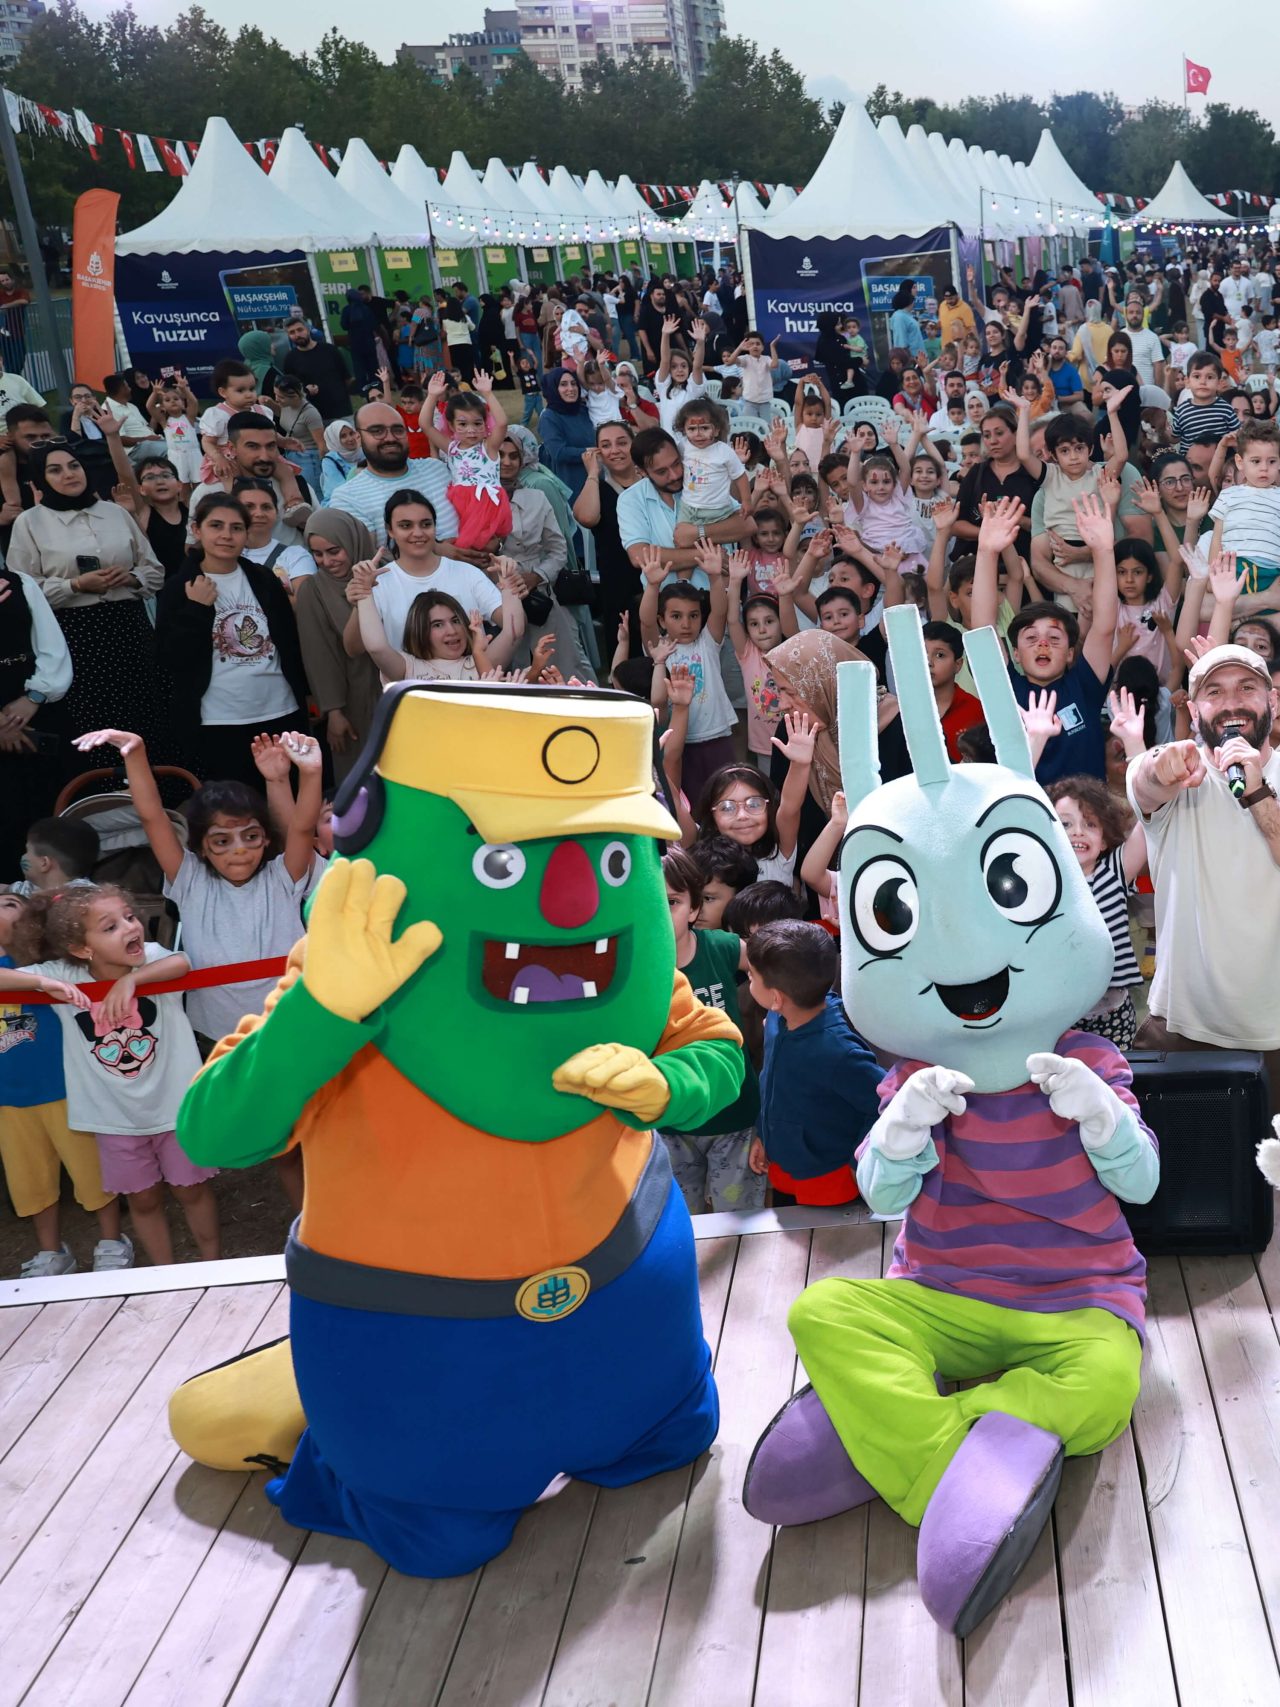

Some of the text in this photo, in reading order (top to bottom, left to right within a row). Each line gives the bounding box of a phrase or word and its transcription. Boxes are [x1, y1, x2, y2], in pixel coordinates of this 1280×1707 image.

[767, 299, 854, 316] Kavuşunca
[132, 311, 220, 327] Kavuşunca
[785, 317, 820, 333] huz
[152, 327, 208, 342] huzur
